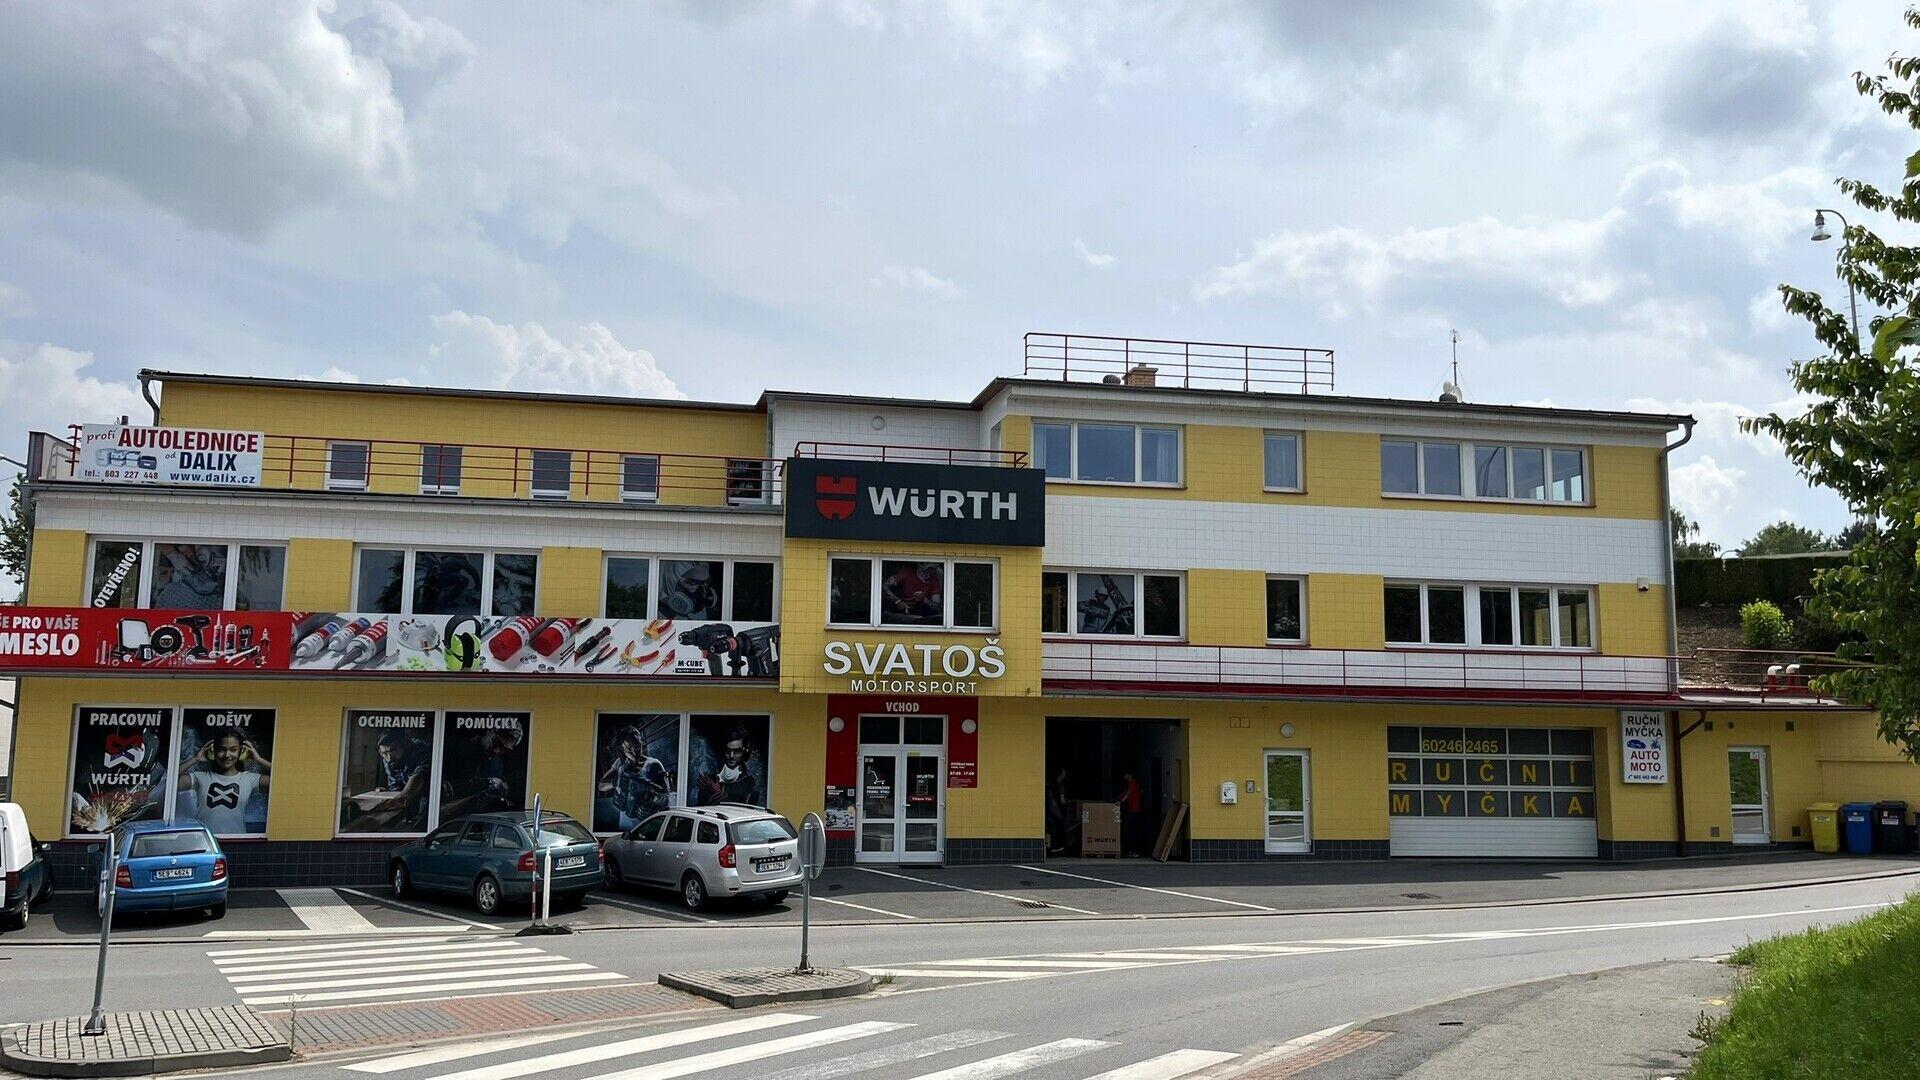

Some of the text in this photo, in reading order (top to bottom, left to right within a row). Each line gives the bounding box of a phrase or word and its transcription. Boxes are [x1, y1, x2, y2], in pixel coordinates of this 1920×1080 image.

[87, 428, 259, 453] profi AUTOLEDNICE
[165, 452, 238, 471] od DALIX
[84, 470, 159, 480] tel.: 603 227 448
[170, 472, 256, 484] www.dalix.cz
[868, 486, 1018, 521] WÜRTH
[94, 547, 140, 608] OTEVŘENO!
[0, 612, 80, 630] E PRO VAŠE
[0, 632, 80, 657] MESLO
[823, 638, 1006, 678] SVATOŠ
[851, 679, 978, 694] MOTORSPORT
[886, 702, 920, 713] VCHOD
[90, 711, 162, 726] PRACOVNÍ
[206, 711, 252, 727] ODĚVY
[358, 713, 426, 728] OCHRANNÉ
[456, 714, 519, 729] POMŮCKY
[1627, 714, 1660, 726] RUČNÍ
[1625, 726, 1663, 737] MYČKA
[1422, 739, 1499, 754] 602462465
[1631, 751, 1660, 760] AUTO
[1631, 762, 1661, 772] MOTO
[91, 773, 151, 785] WÜRTH
